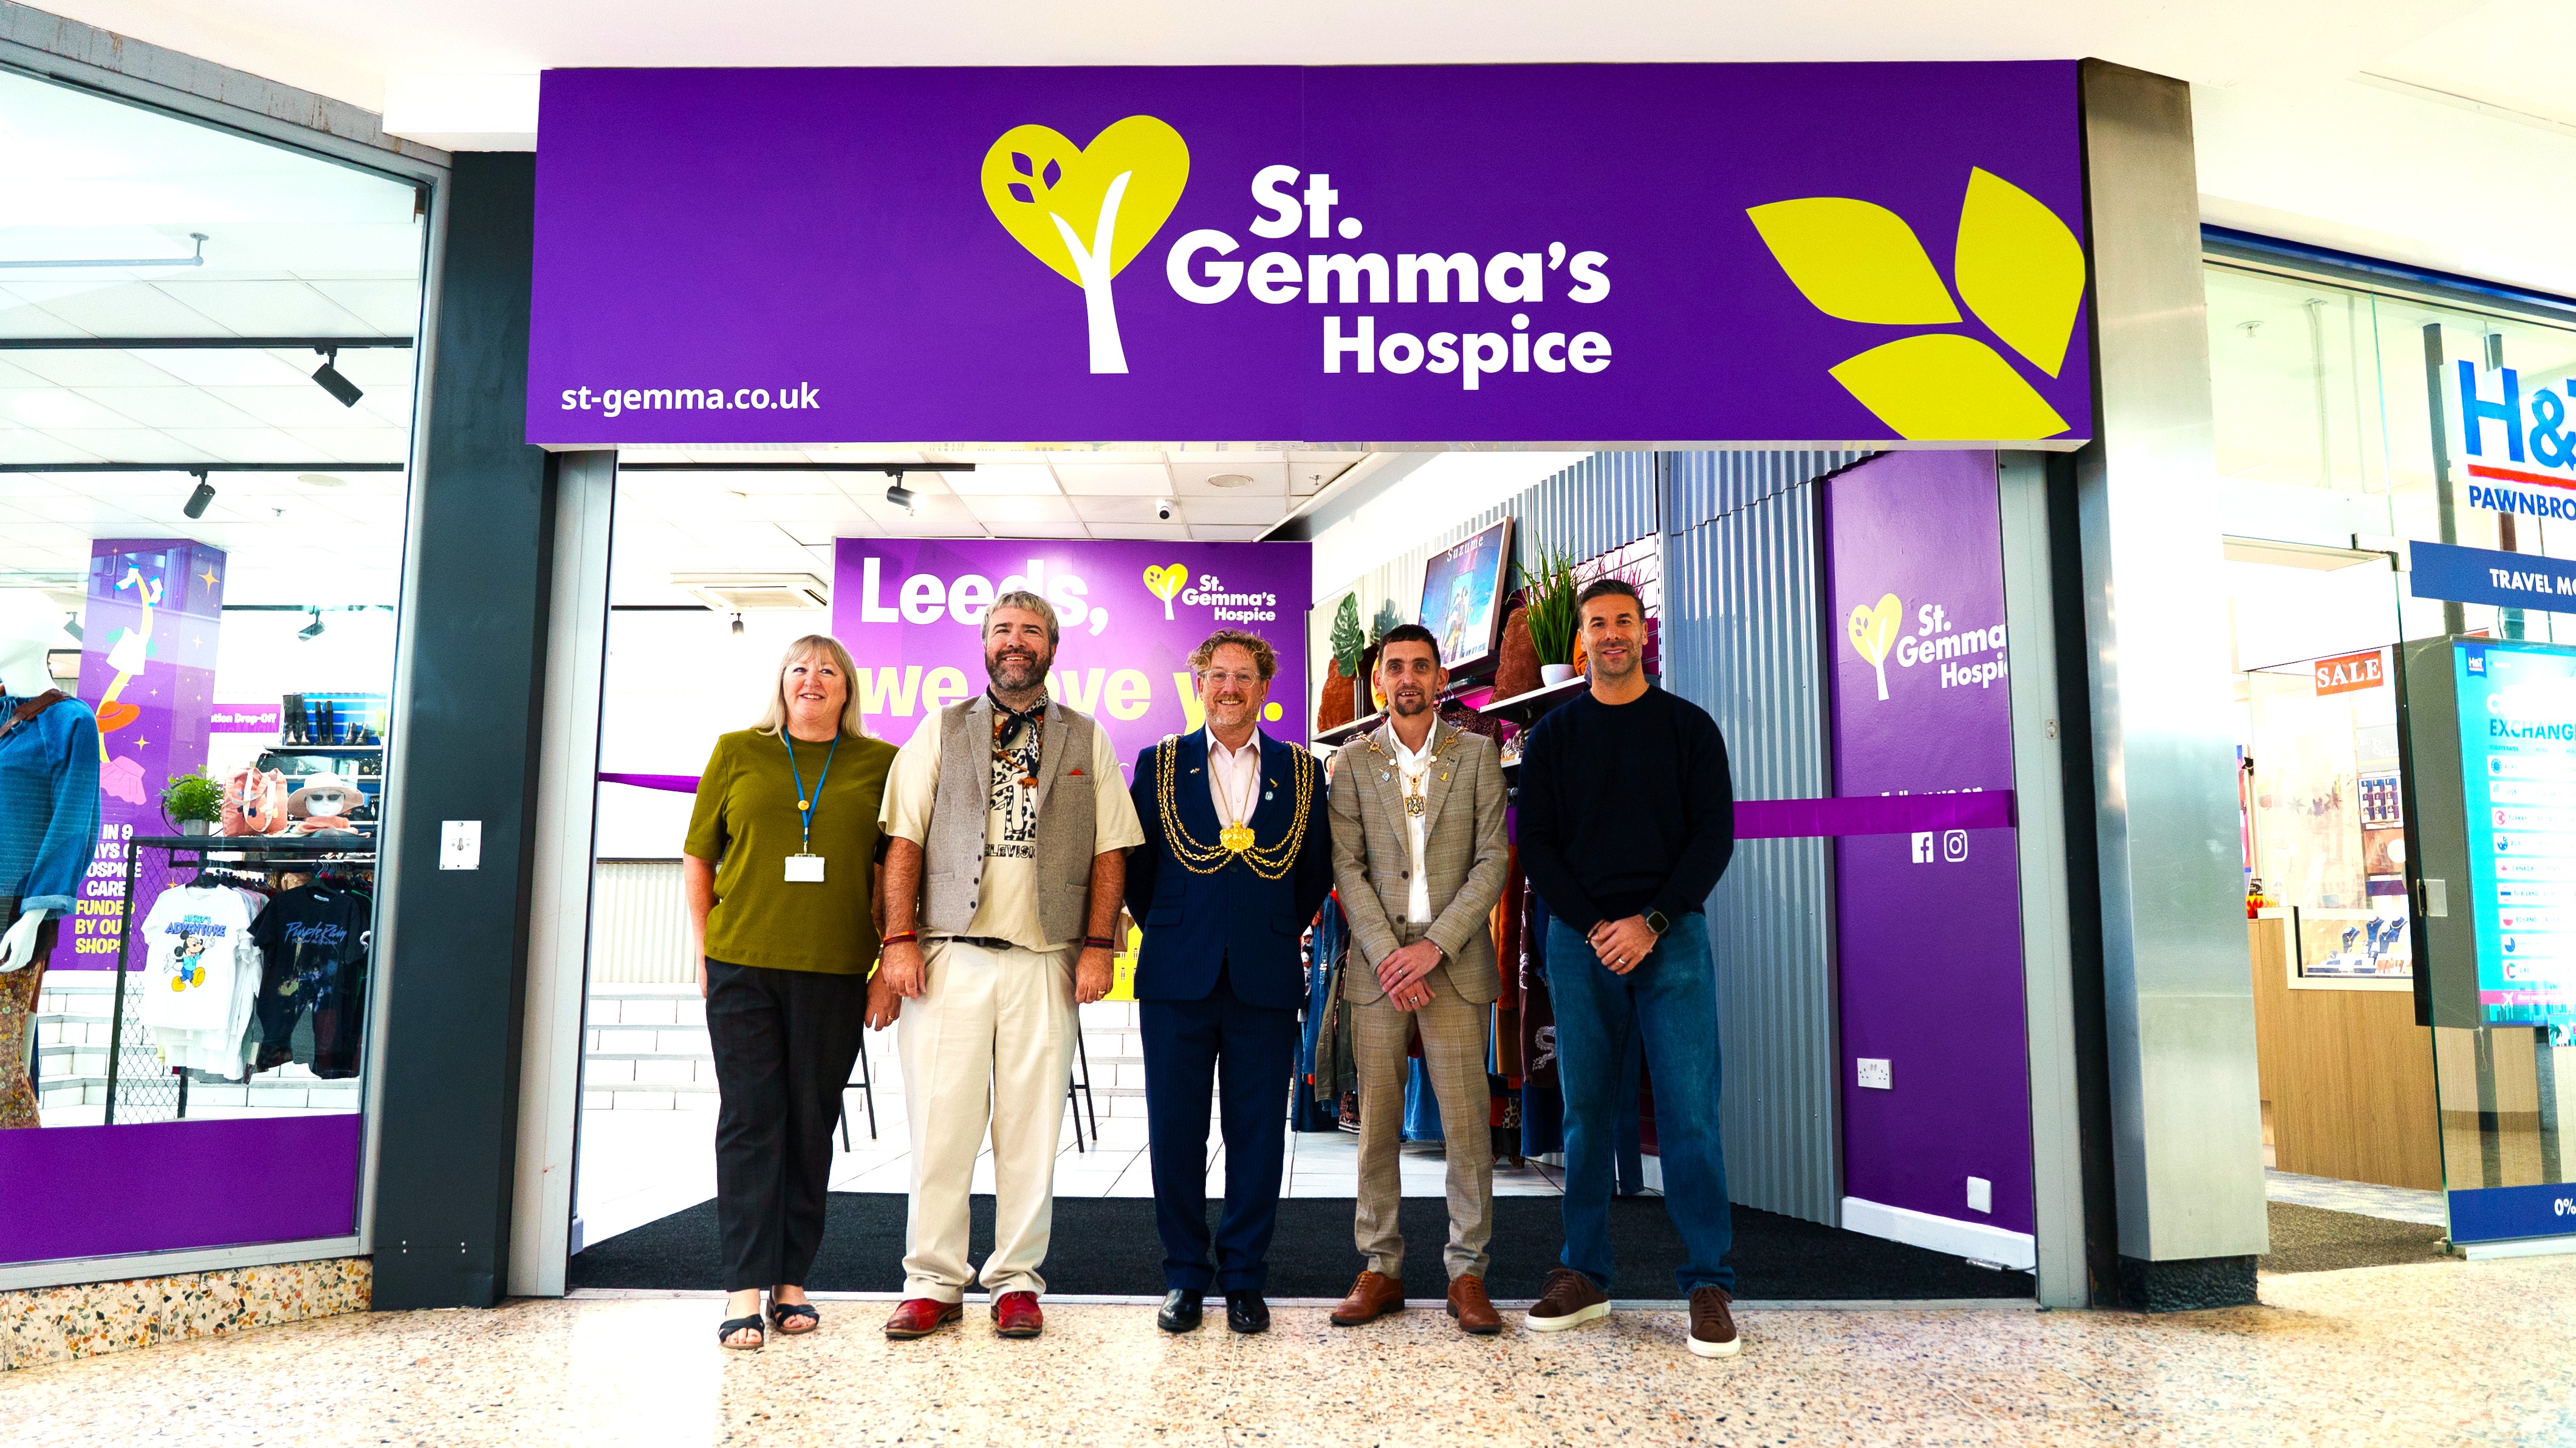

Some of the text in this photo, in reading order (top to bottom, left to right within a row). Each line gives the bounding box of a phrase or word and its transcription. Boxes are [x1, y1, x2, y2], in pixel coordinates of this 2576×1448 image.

[1249, 165, 1363, 239] St.
[1166, 228, 1611, 304] Gemma's
[1323, 313, 1612, 391] Hospice
[561, 381, 820, 418] st-gemma.co.uk
[1447, 536, 1484, 562] Suzume
[1199, 574, 1224, 592] St.
[2490, 569, 2553, 593] TRAVEL
[1181, 587, 1276, 606] Gemma's
[1214, 607, 1276, 624] Hospice
[1918, 604, 1951, 637] St.
[1896, 624, 2006, 668] Gemma
[1941, 651, 2009, 689] Hospi
[2317, 658, 2381, 688] SALE
[855, 665, 968, 717] we
[234, 712, 278, 726] Drop-Off
[2489, 718, 2576, 742] EXCHANG
[102, 823, 134, 841] IN 9
[984, 844, 1036, 859] ELEVISI
[86, 880, 127, 897] CARE
[75, 918, 97, 935] BY
[165, 921, 227, 938] ADVENTURE
[2554, 1198, 2576, 1217] 0%
